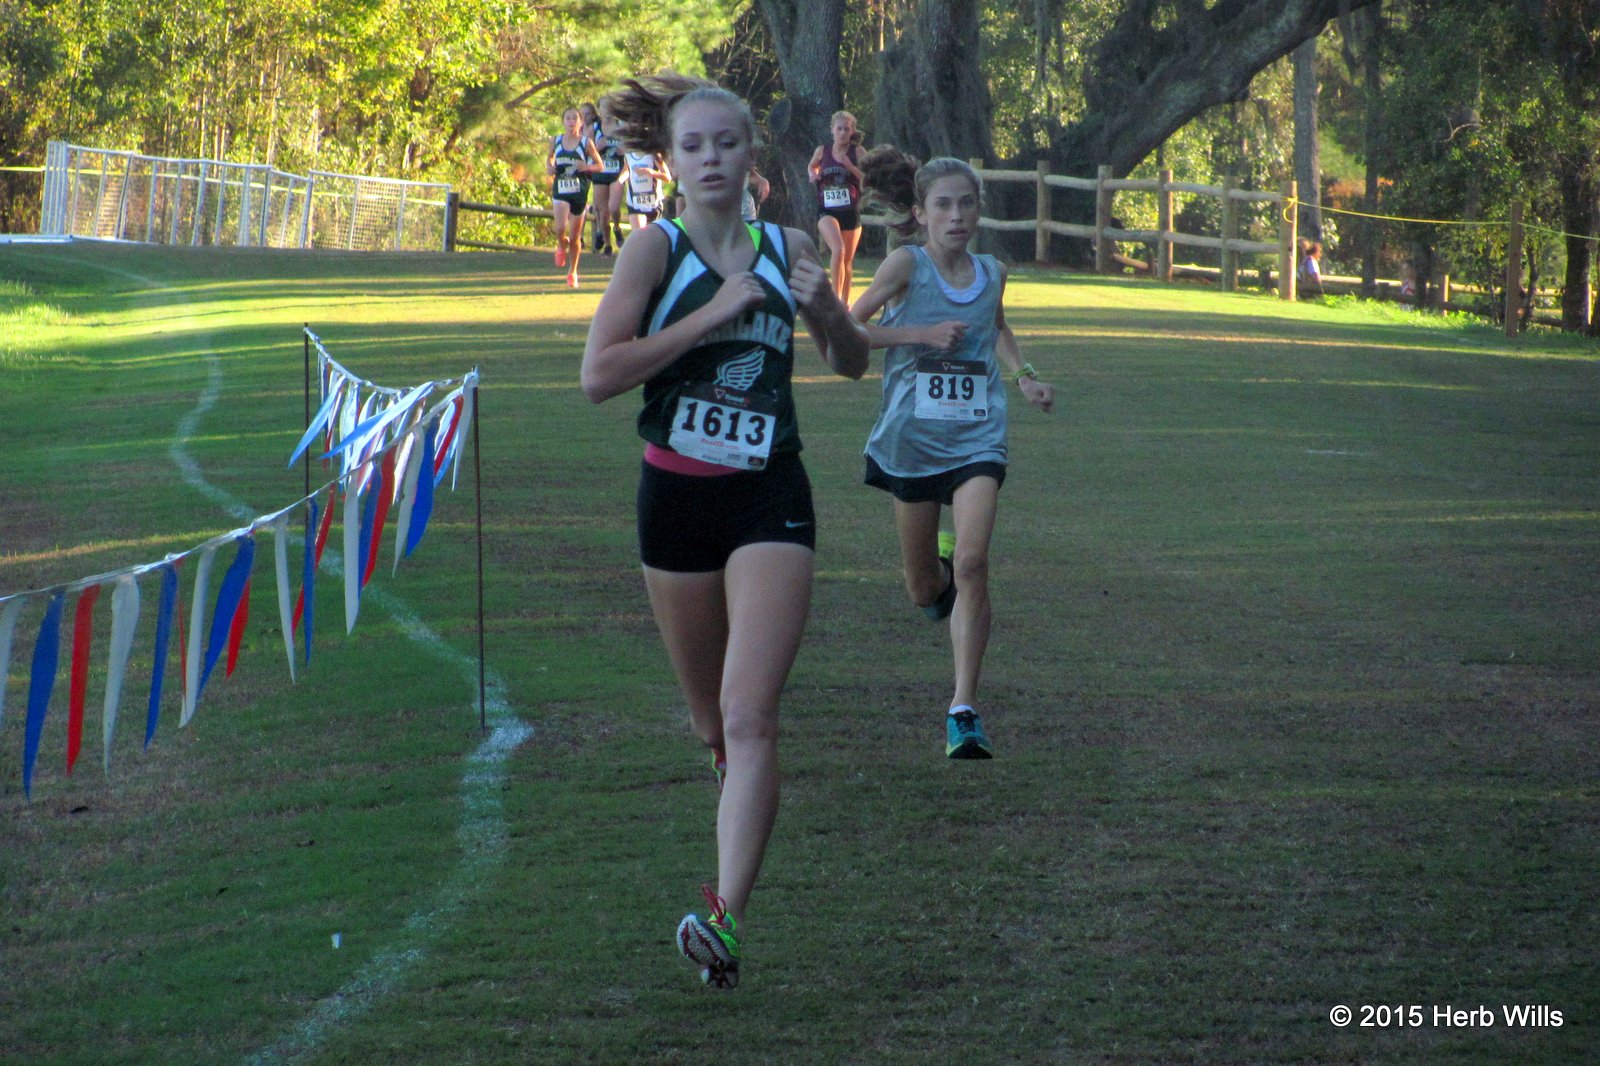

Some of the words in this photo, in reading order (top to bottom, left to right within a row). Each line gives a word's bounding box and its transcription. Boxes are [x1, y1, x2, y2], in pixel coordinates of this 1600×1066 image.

[560, 179, 579, 188] 1616
[637, 195, 652, 205] 824
[825, 189, 847, 200] 5324
[928, 375, 975, 401] 819
[681, 401, 767, 447] 1613
